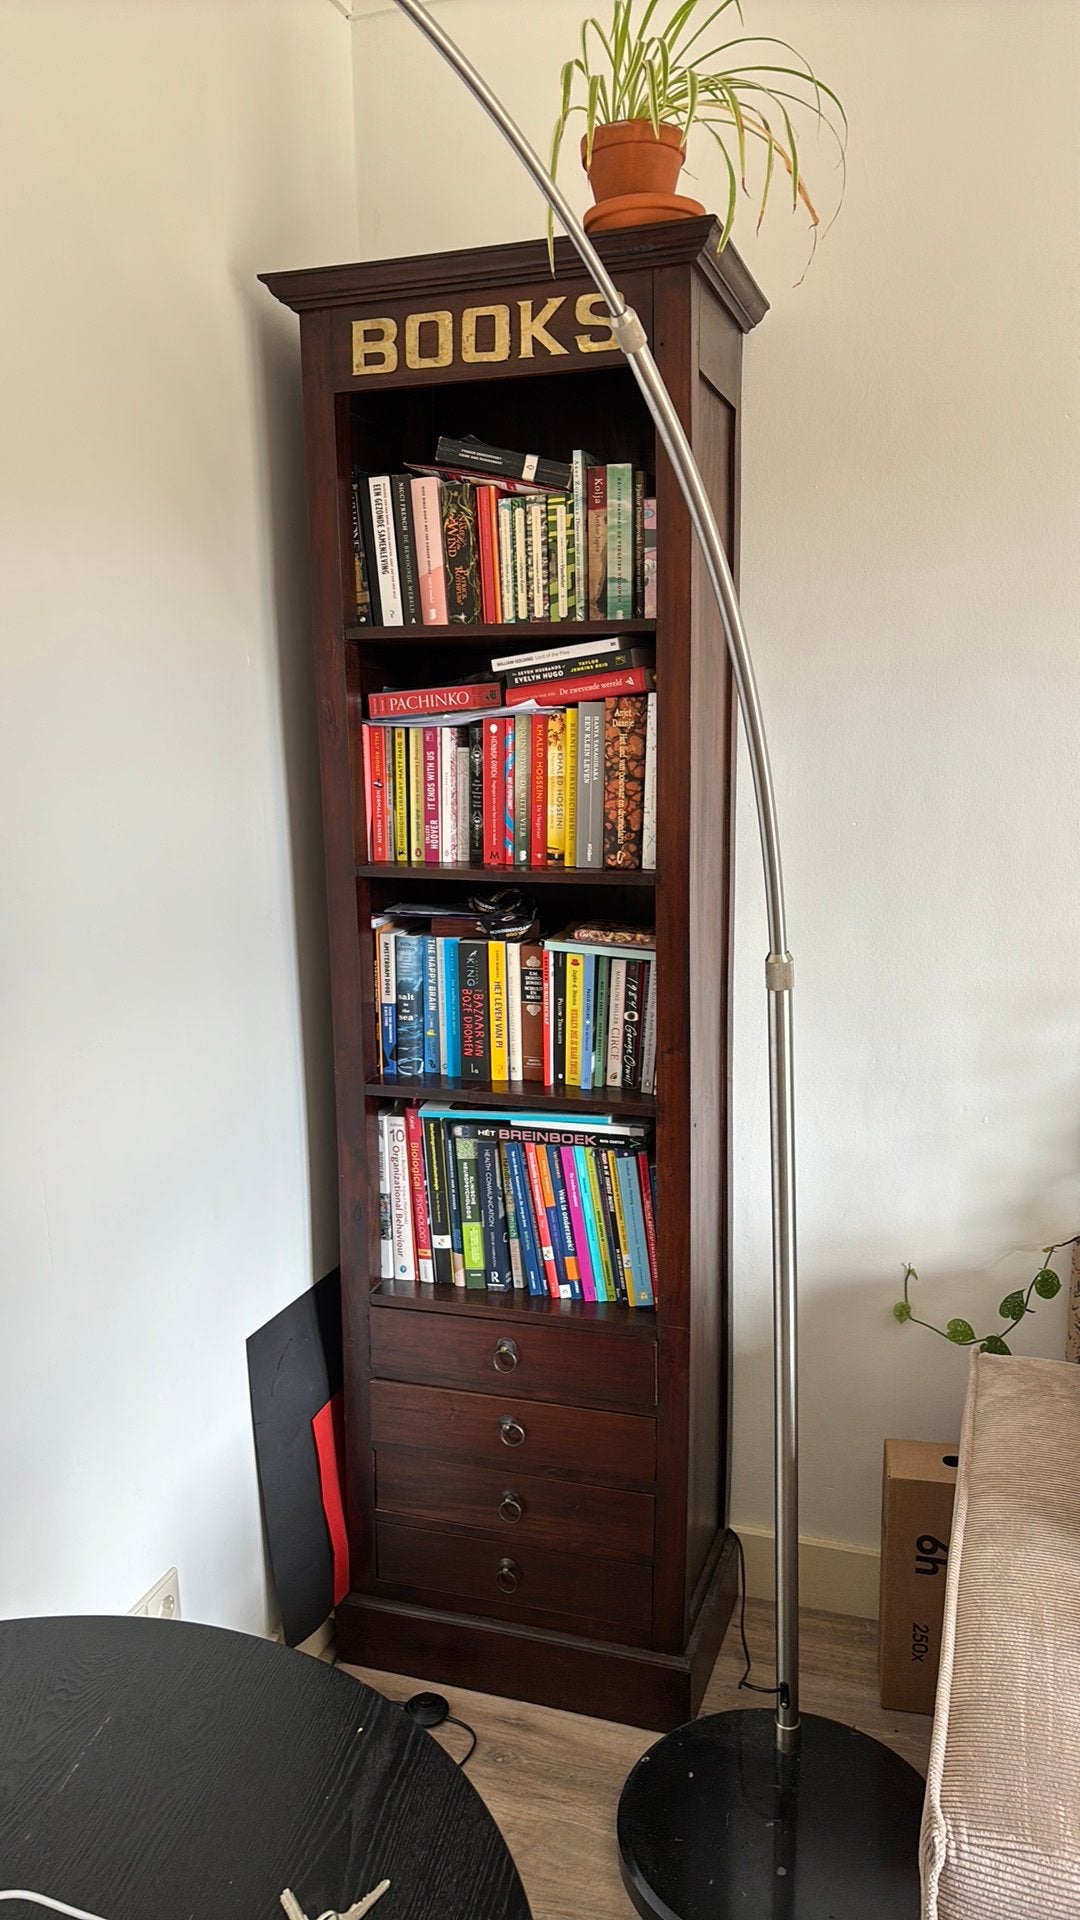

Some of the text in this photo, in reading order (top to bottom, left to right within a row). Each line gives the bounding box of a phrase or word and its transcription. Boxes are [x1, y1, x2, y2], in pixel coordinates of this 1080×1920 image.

[352, 291, 625, 376] BOOKS
[593, 478, 603, 504] Kolja
[373, 484, 389, 574] EEN GEZONDE SAMENLEVING
[403, 535, 409, 543] DE
[447, 522, 458, 557] WIND
[618, 531, 621, 539] DE
[404, 546, 412, 583] BEWOONDE
[454, 566, 463, 603] ROTHFUSS
[461, 569, 469, 599] PATRICK
[515, 670, 563, 684] EVELYN HUGO
[534, 665, 562, 674] HUSBANDS
[570, 664, 593, 673] JENKINS
[390, 691, 470, 712] PACHINKO
[559, 679, 622, 696] De zwevende wereld
[615, 709, 632, 719] Anjet
[426, 751, 434, 760] US
[619, 746, 627, 757] lied
[427, 762, 435, 781] WITH
[520, 780, 526, 790] DE
[617, 772, 625, 798] ooievaar
[427, 783, 435, 802] ENDS
[618, 799, 624, 807] en
[537, 805, 542, 813] De
[430, 819, 438, 849] HOOVER
[618, 809, 626, 844] dromedaris
[427, 939, 435, 955] THE
[466, 957, 475, 987] KING
[494, 981, 502, 996] HET
[462, 988, 473, 1056] BOZE DROMEN
[474, 994, 485, 1056] BAZAAR VAN
[623, 977, 638, 1084] 1984 George Orwell
[610, 1027, 620, 1060] CIRCE
[570, 1061, 578, 1075] THUIS
[389, 1129, 405, 1142] 10
[477, 1129, 597, 1146] HÉT BREINBOEK
[410, 1142, 421, 1190] Biological
[416, 1194, 427, 1244] PSYCHOLOGY
[463, 1162, 471, 1220] NEUROPSYCHOLOGIE
[484, 1149, 494, 1227] HEALTH COMMUNICATION
[503, 1158, 517, 1237] Handboek academisch
[529, 1151, 537, 1177] Introductie
[534, 1184, 543, 1216] management
[391, 1145, 405, 1257] Organizational Behaviour
[552, 1151, 561, 1179] Verhoeven
[558, 1189, 566, 1202] Wat
[562, 1212, 574, 1251] onderzoek?
[915, 1534, 948, 1576] 6h
[911, 1623, 929, 1663] 250x
